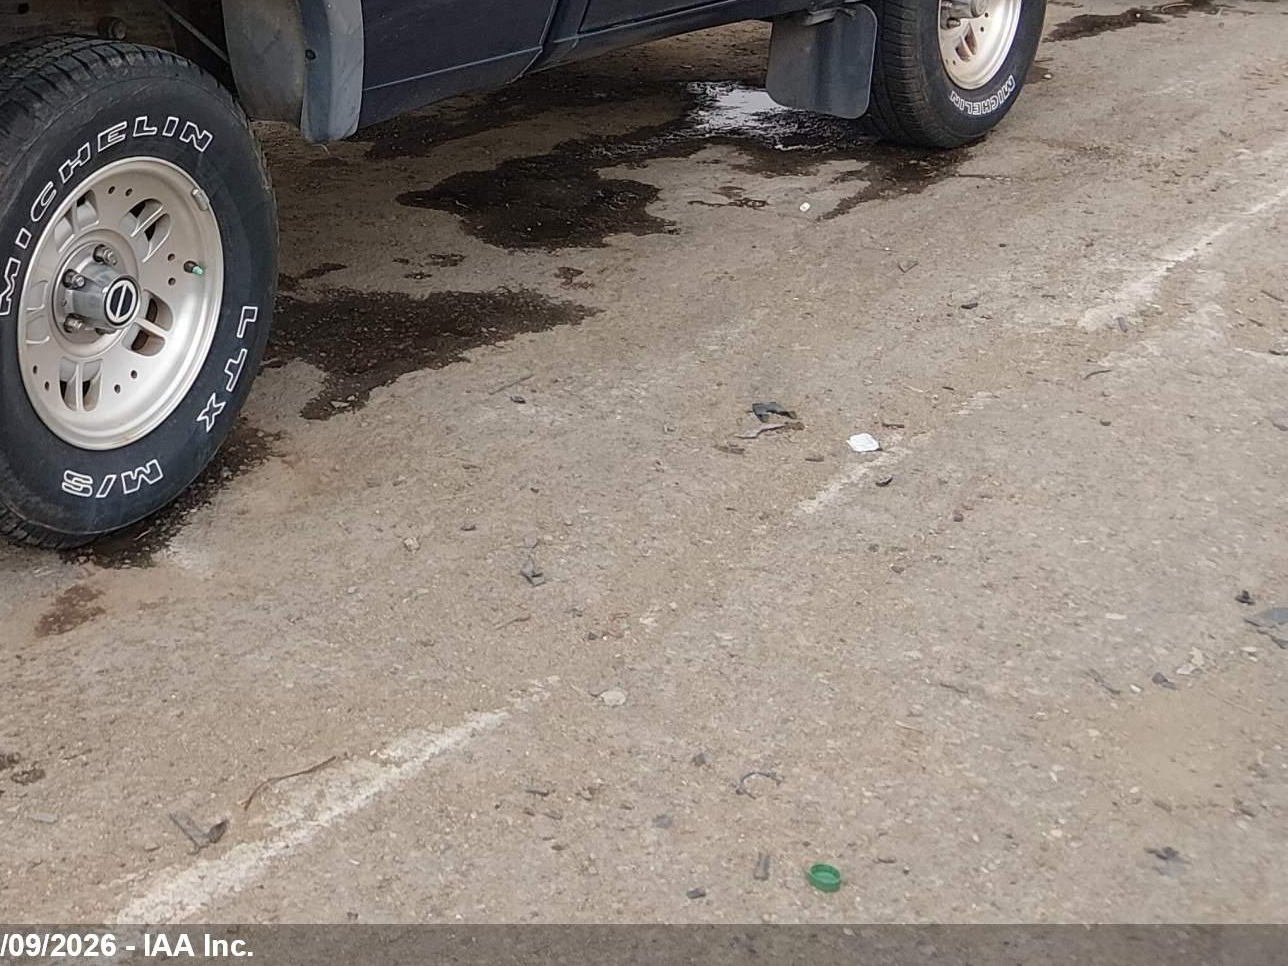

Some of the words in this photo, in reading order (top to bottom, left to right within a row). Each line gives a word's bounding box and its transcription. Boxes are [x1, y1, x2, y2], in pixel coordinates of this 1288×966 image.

[950, 74, 1016, 115] MICHELIN
[197, 306, 259, 433] LTX
[61, 459, 164, 499] M/S
